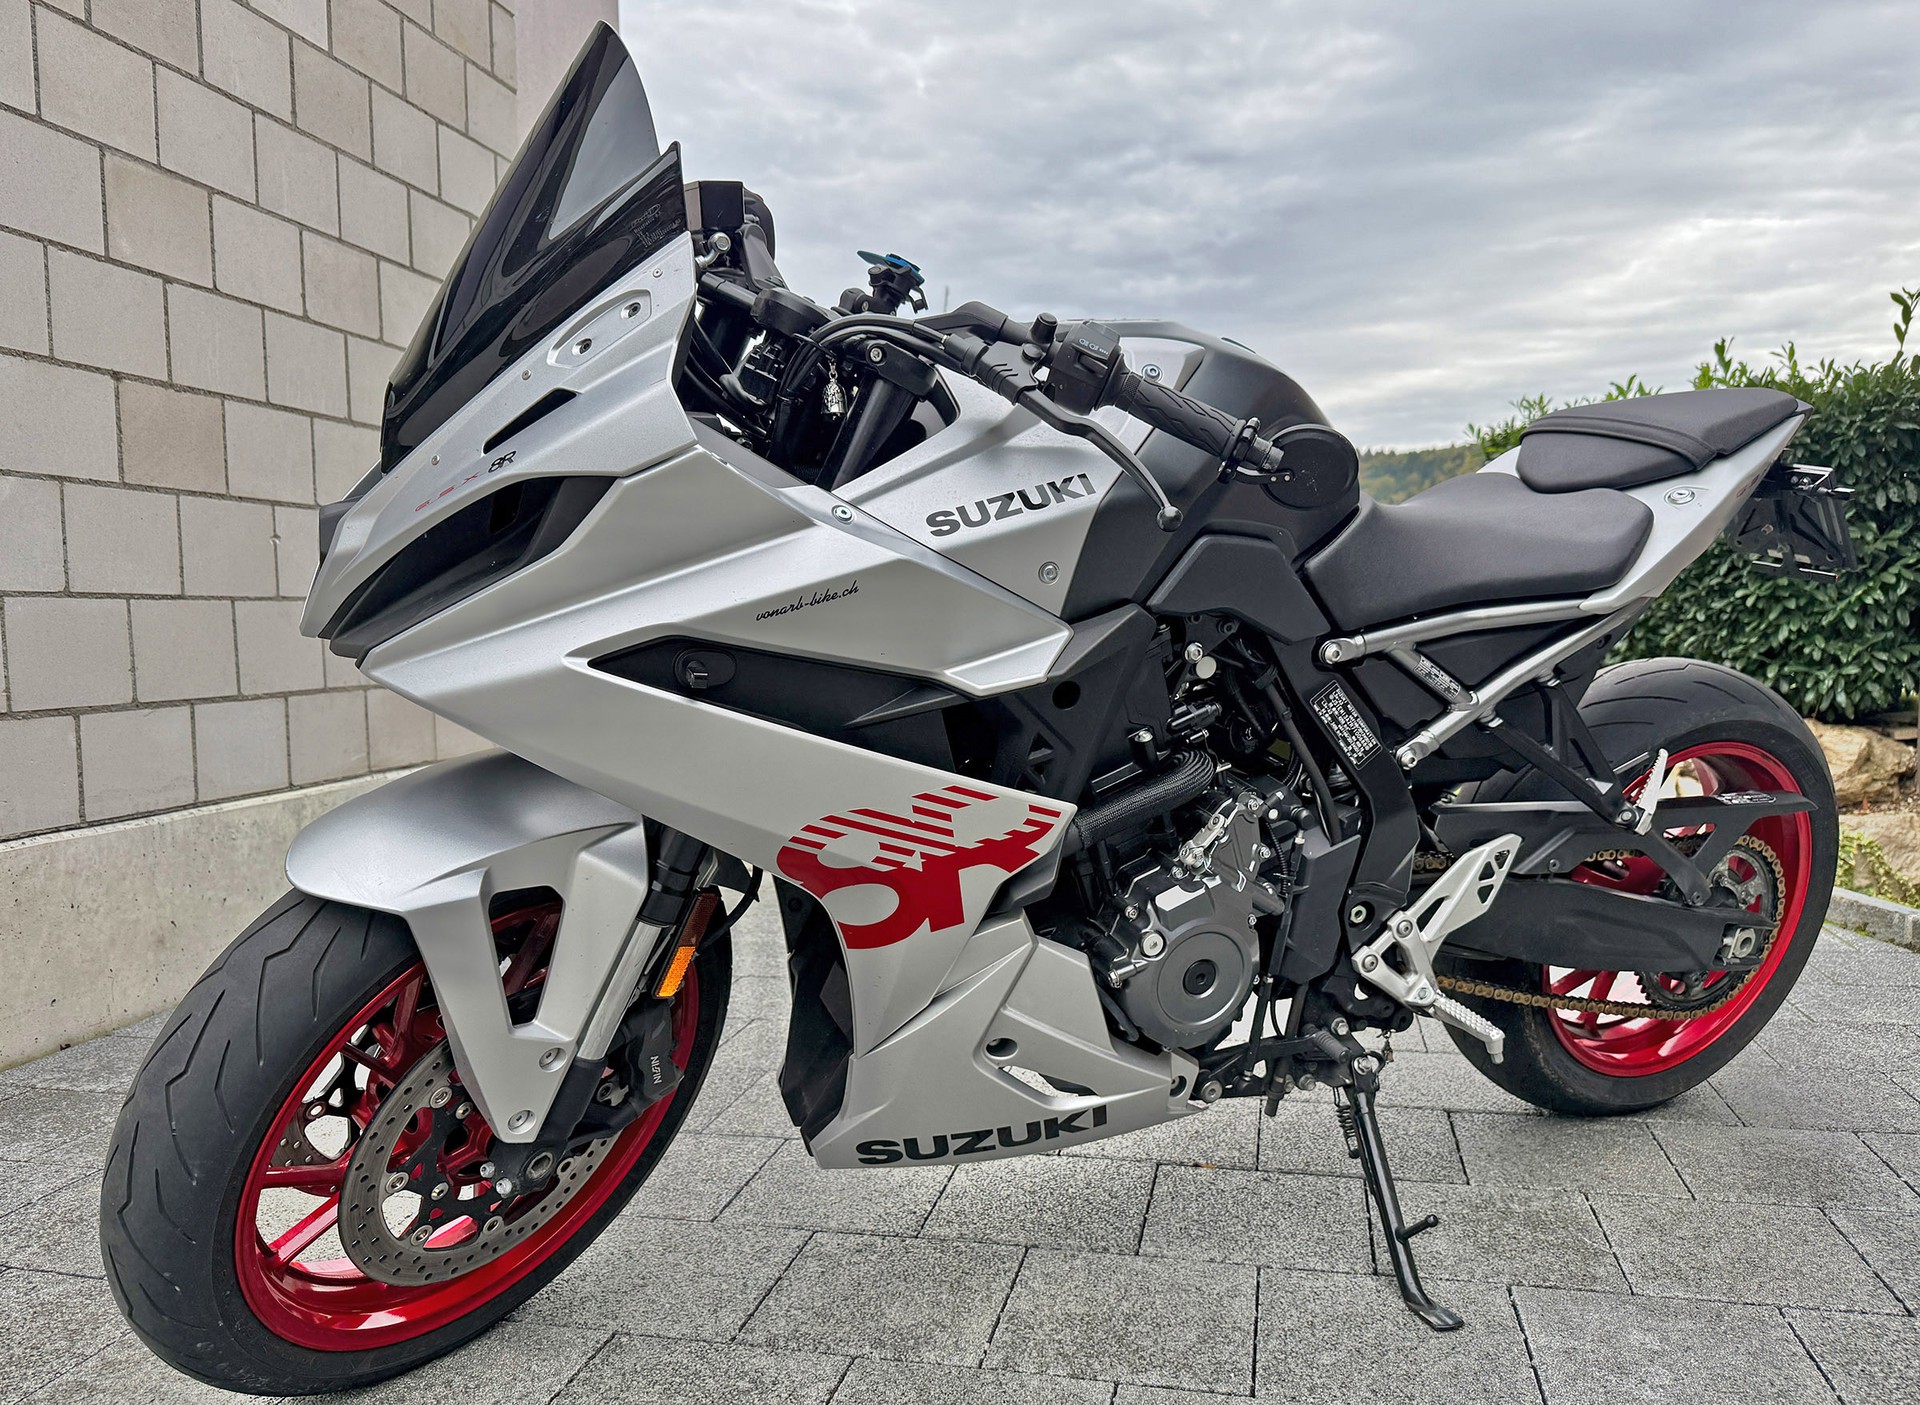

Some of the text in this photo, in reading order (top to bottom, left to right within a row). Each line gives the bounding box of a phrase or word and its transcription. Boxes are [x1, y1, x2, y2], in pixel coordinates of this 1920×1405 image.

[925, 472, 1097, 537] SUZUKI
[755, 579, 860, 622] vonarb-bike.ch
[854, 1104, 1108, 1165] SUZUKI
